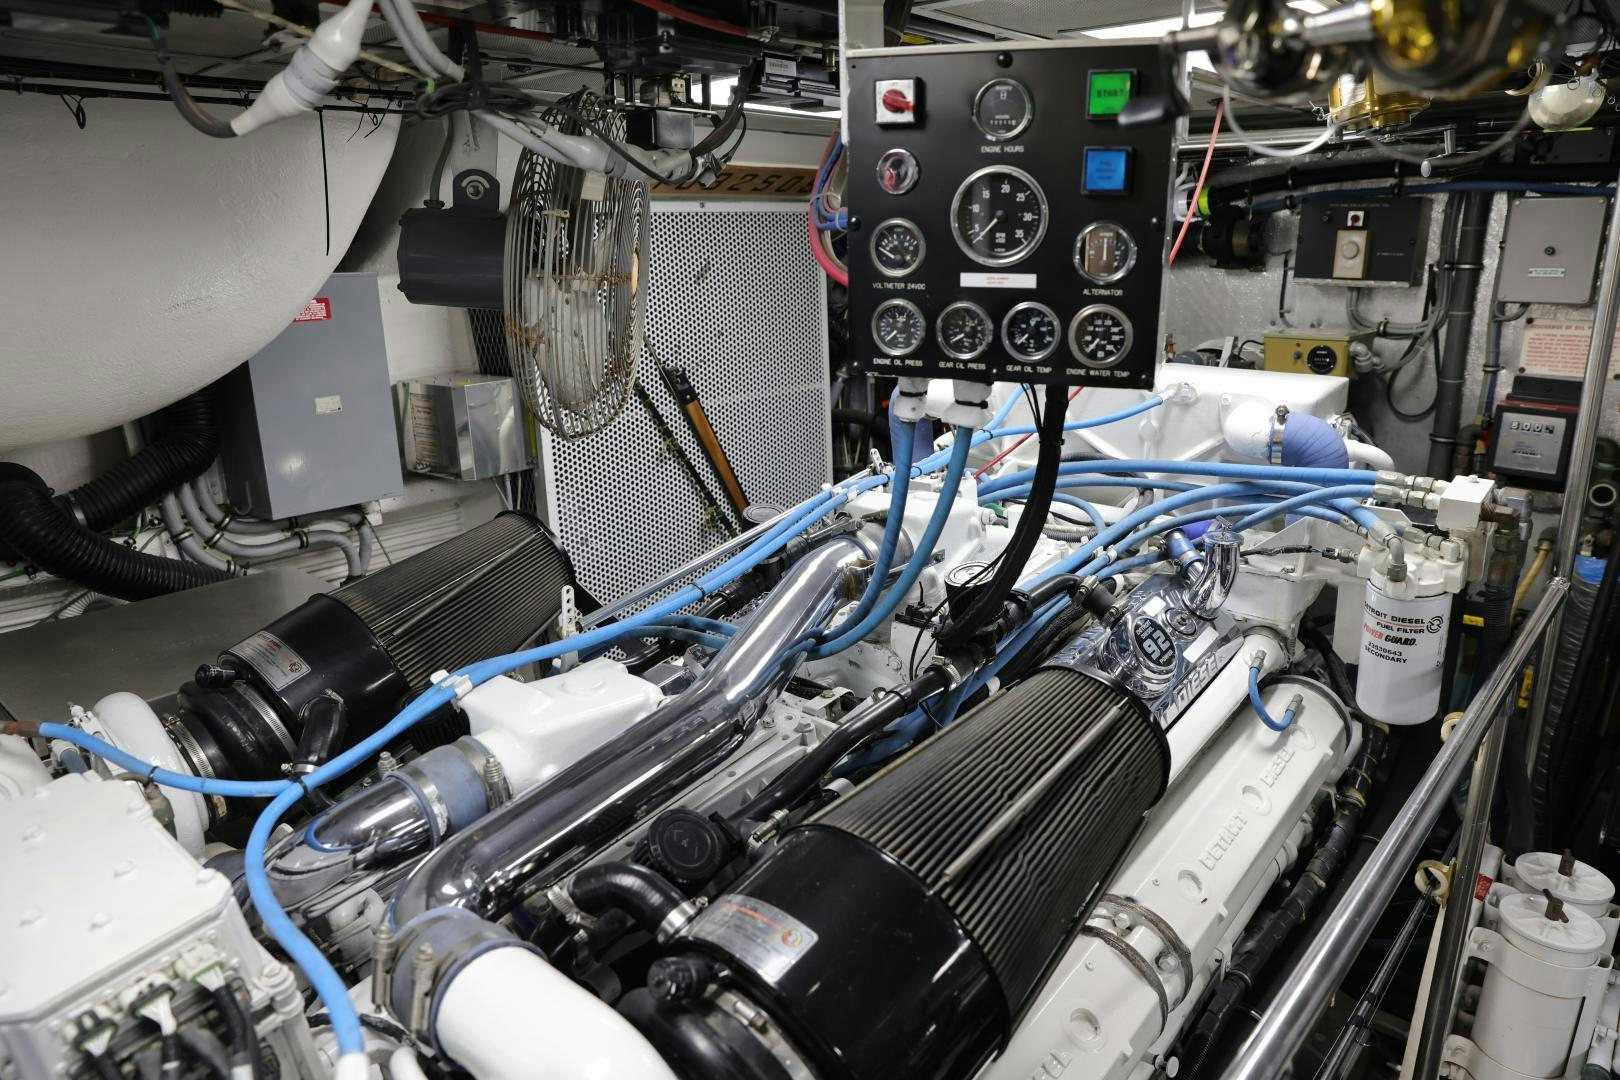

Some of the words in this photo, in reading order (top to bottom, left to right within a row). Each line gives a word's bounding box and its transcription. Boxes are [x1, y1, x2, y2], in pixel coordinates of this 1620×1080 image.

[1001, 184, 1010, 193] 20
[982, 190, 990, 198] 15
[1016, 192, 1025, 201] 25
[1023, 212, 1032, 221] 30
[1015, 230, 1024, 238] 35
[1391, 616, 1425, 624] DIESEL
[1136, 620, 1151, 635] DETROIT
[1377, 622, 1394, 632] FUEL
[1140, 626, 1154, 640] DIESEL
[1364, 624, 1384, 640] POWER
[1385, 635, 1416, 646] GUARD
[1143, 630, 1170, 660] 92
[1160, 649, 1173, 664] POWER
[1365, 645, 1408, 664] SECONDARY
